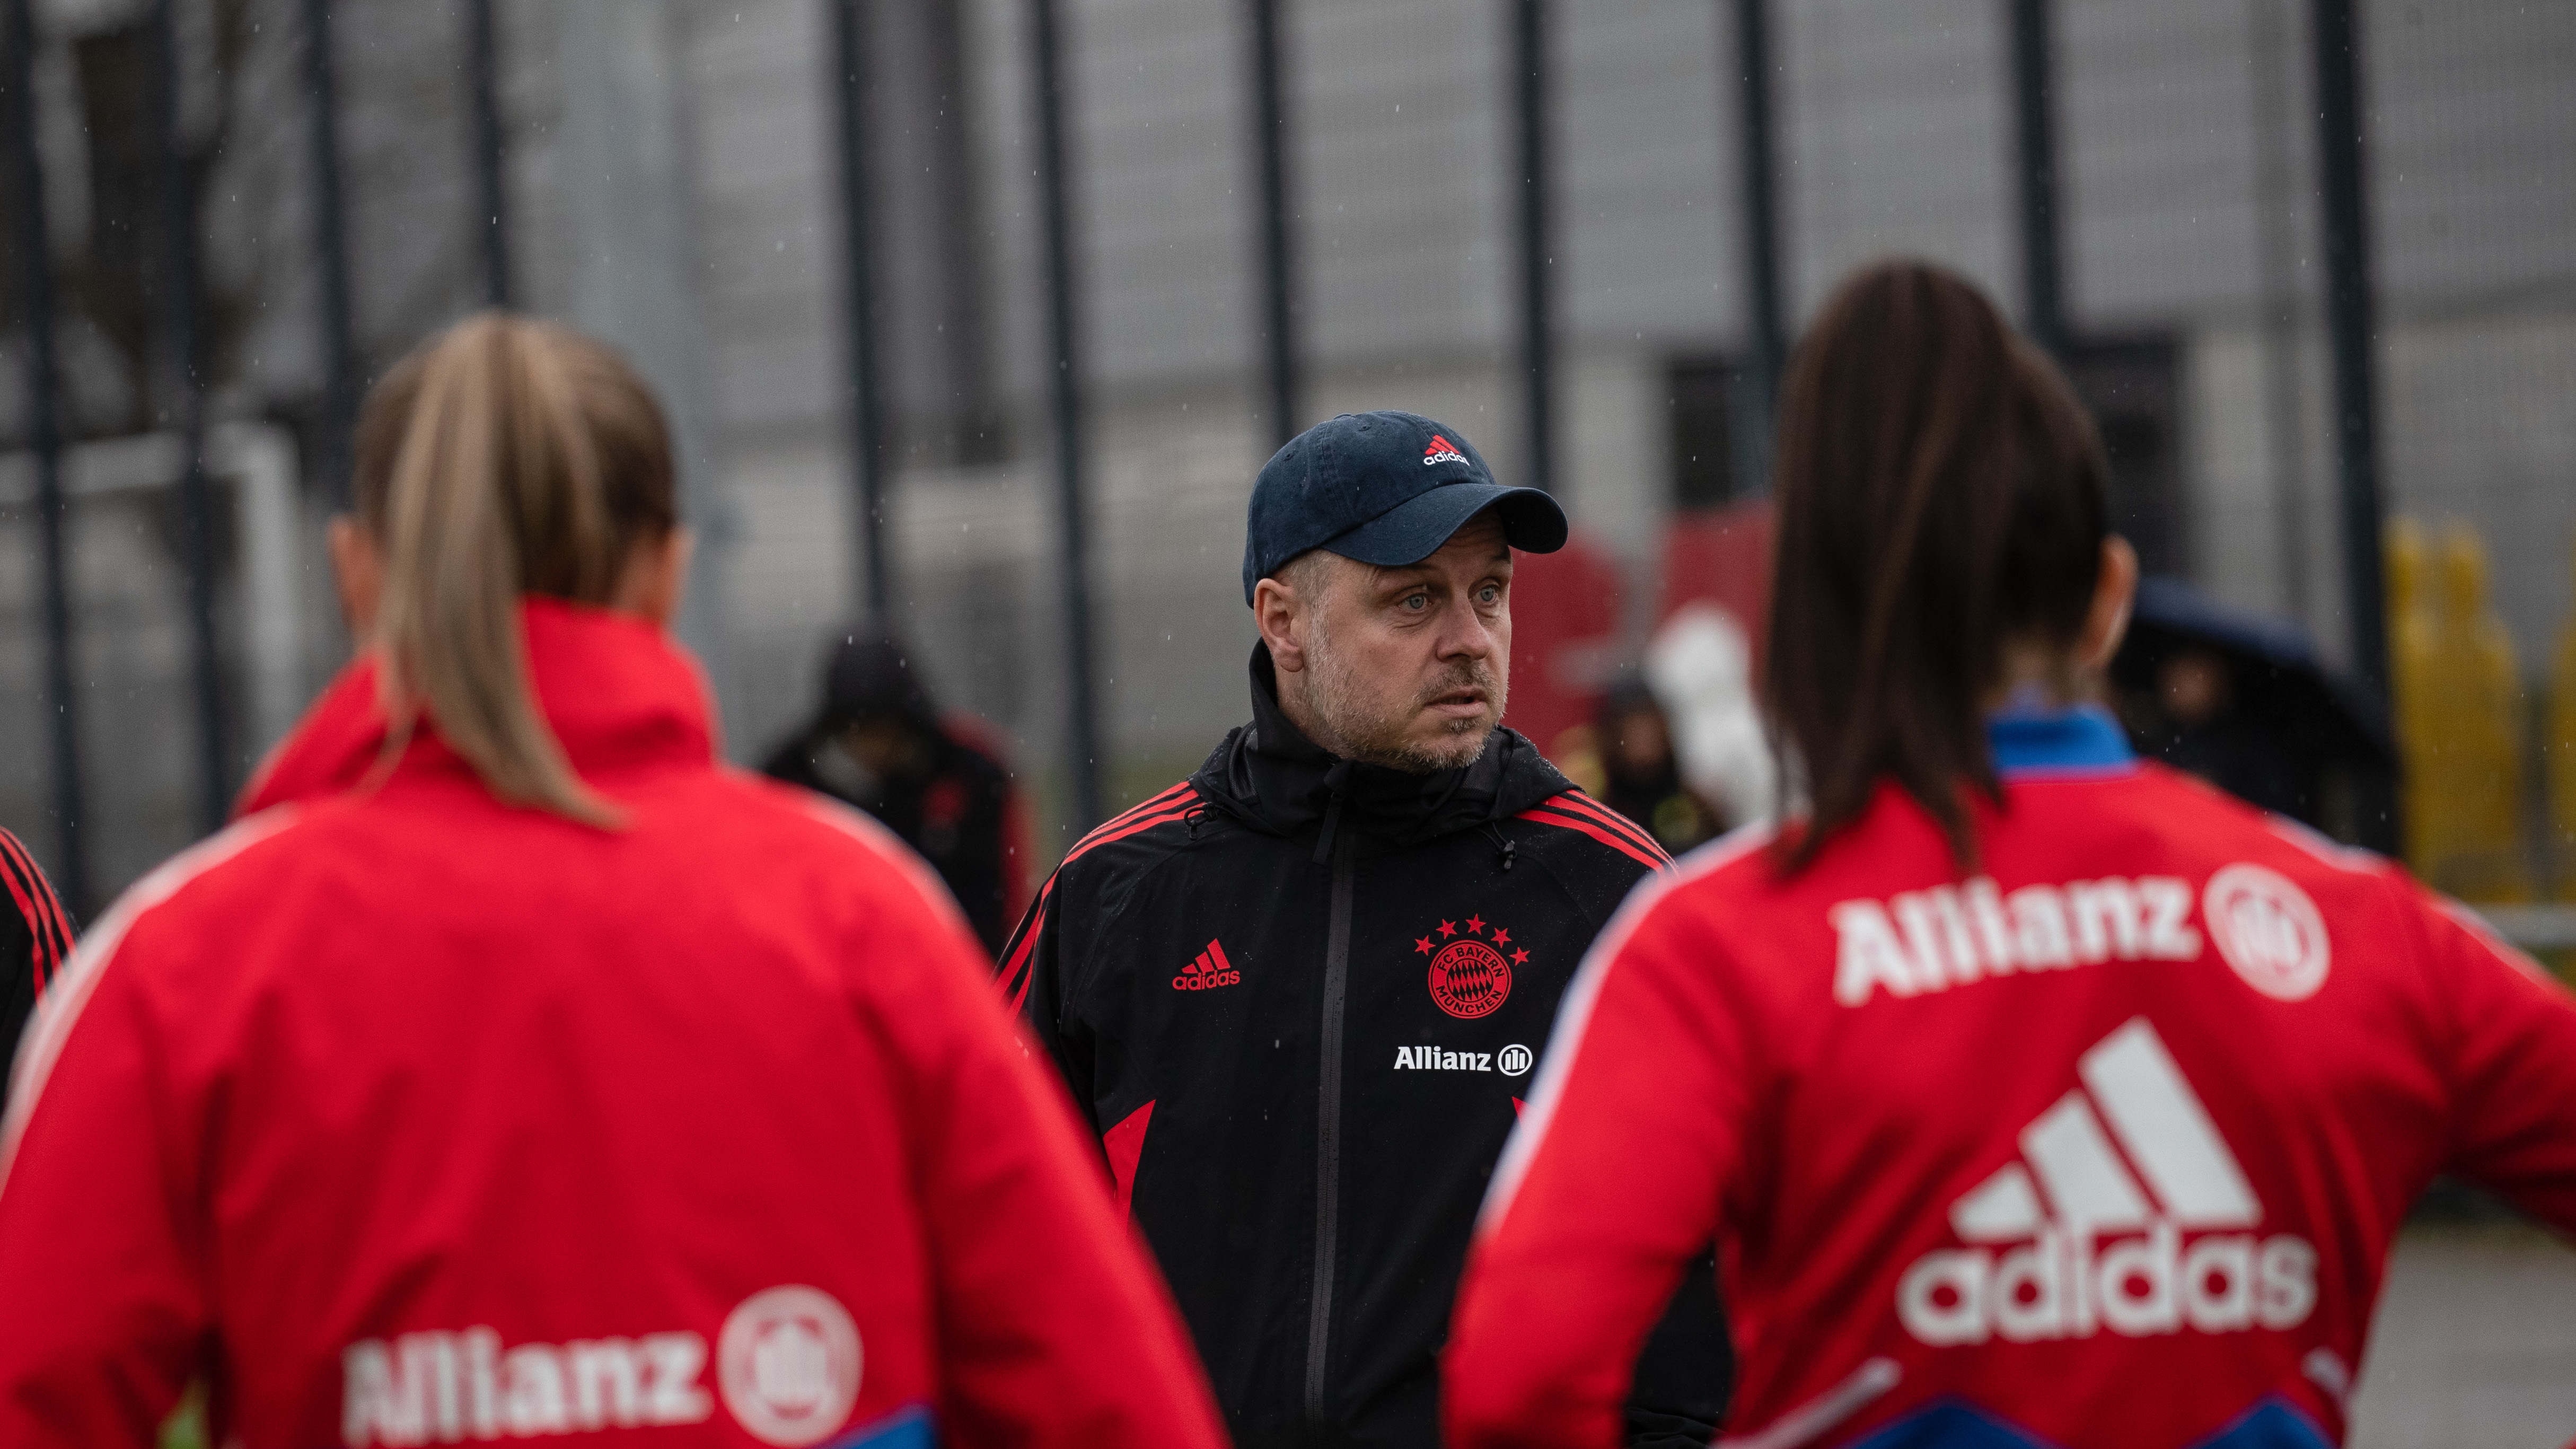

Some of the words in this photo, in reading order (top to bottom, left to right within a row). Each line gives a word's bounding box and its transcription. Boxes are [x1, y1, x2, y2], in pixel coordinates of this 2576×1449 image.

[1438, 954, 1453, 971] FC
[1456, 947, 1505, 977] BAYERN
[1828, 876, 2202, 1005] Allianz
[1172, 970, 1240, 990] adidas
[1394, 1046, 1491, 1071] Allianz
[1896, 1227, 2318, 1346] adidas
[341, 1325, 714, 1446] Allianz
